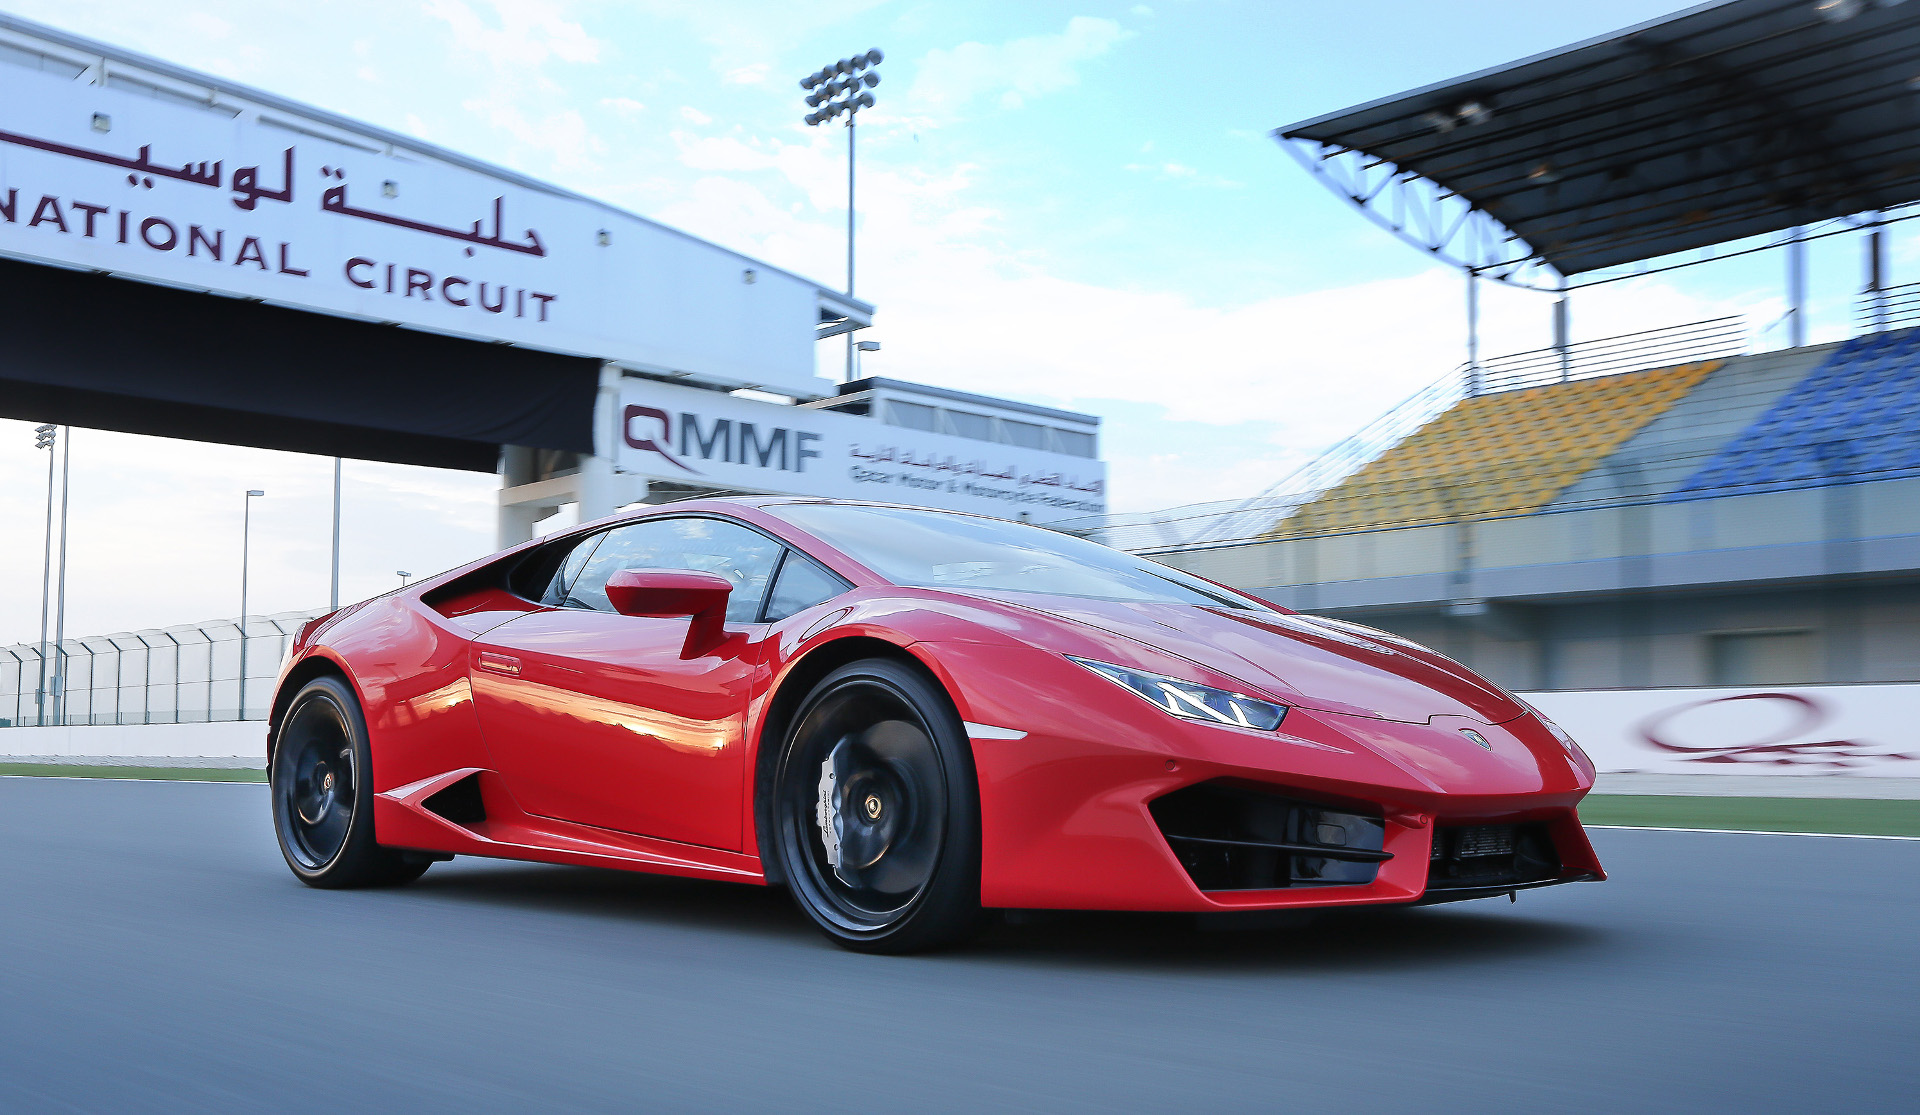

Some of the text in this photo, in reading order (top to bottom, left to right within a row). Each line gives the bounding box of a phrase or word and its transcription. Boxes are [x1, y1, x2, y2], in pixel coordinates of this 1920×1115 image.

[0, 130, 548, 259] حلبة لوسي
[345, 256, 558, 322] CIRCUIT
[624, 404, 823, 476] QMMF
